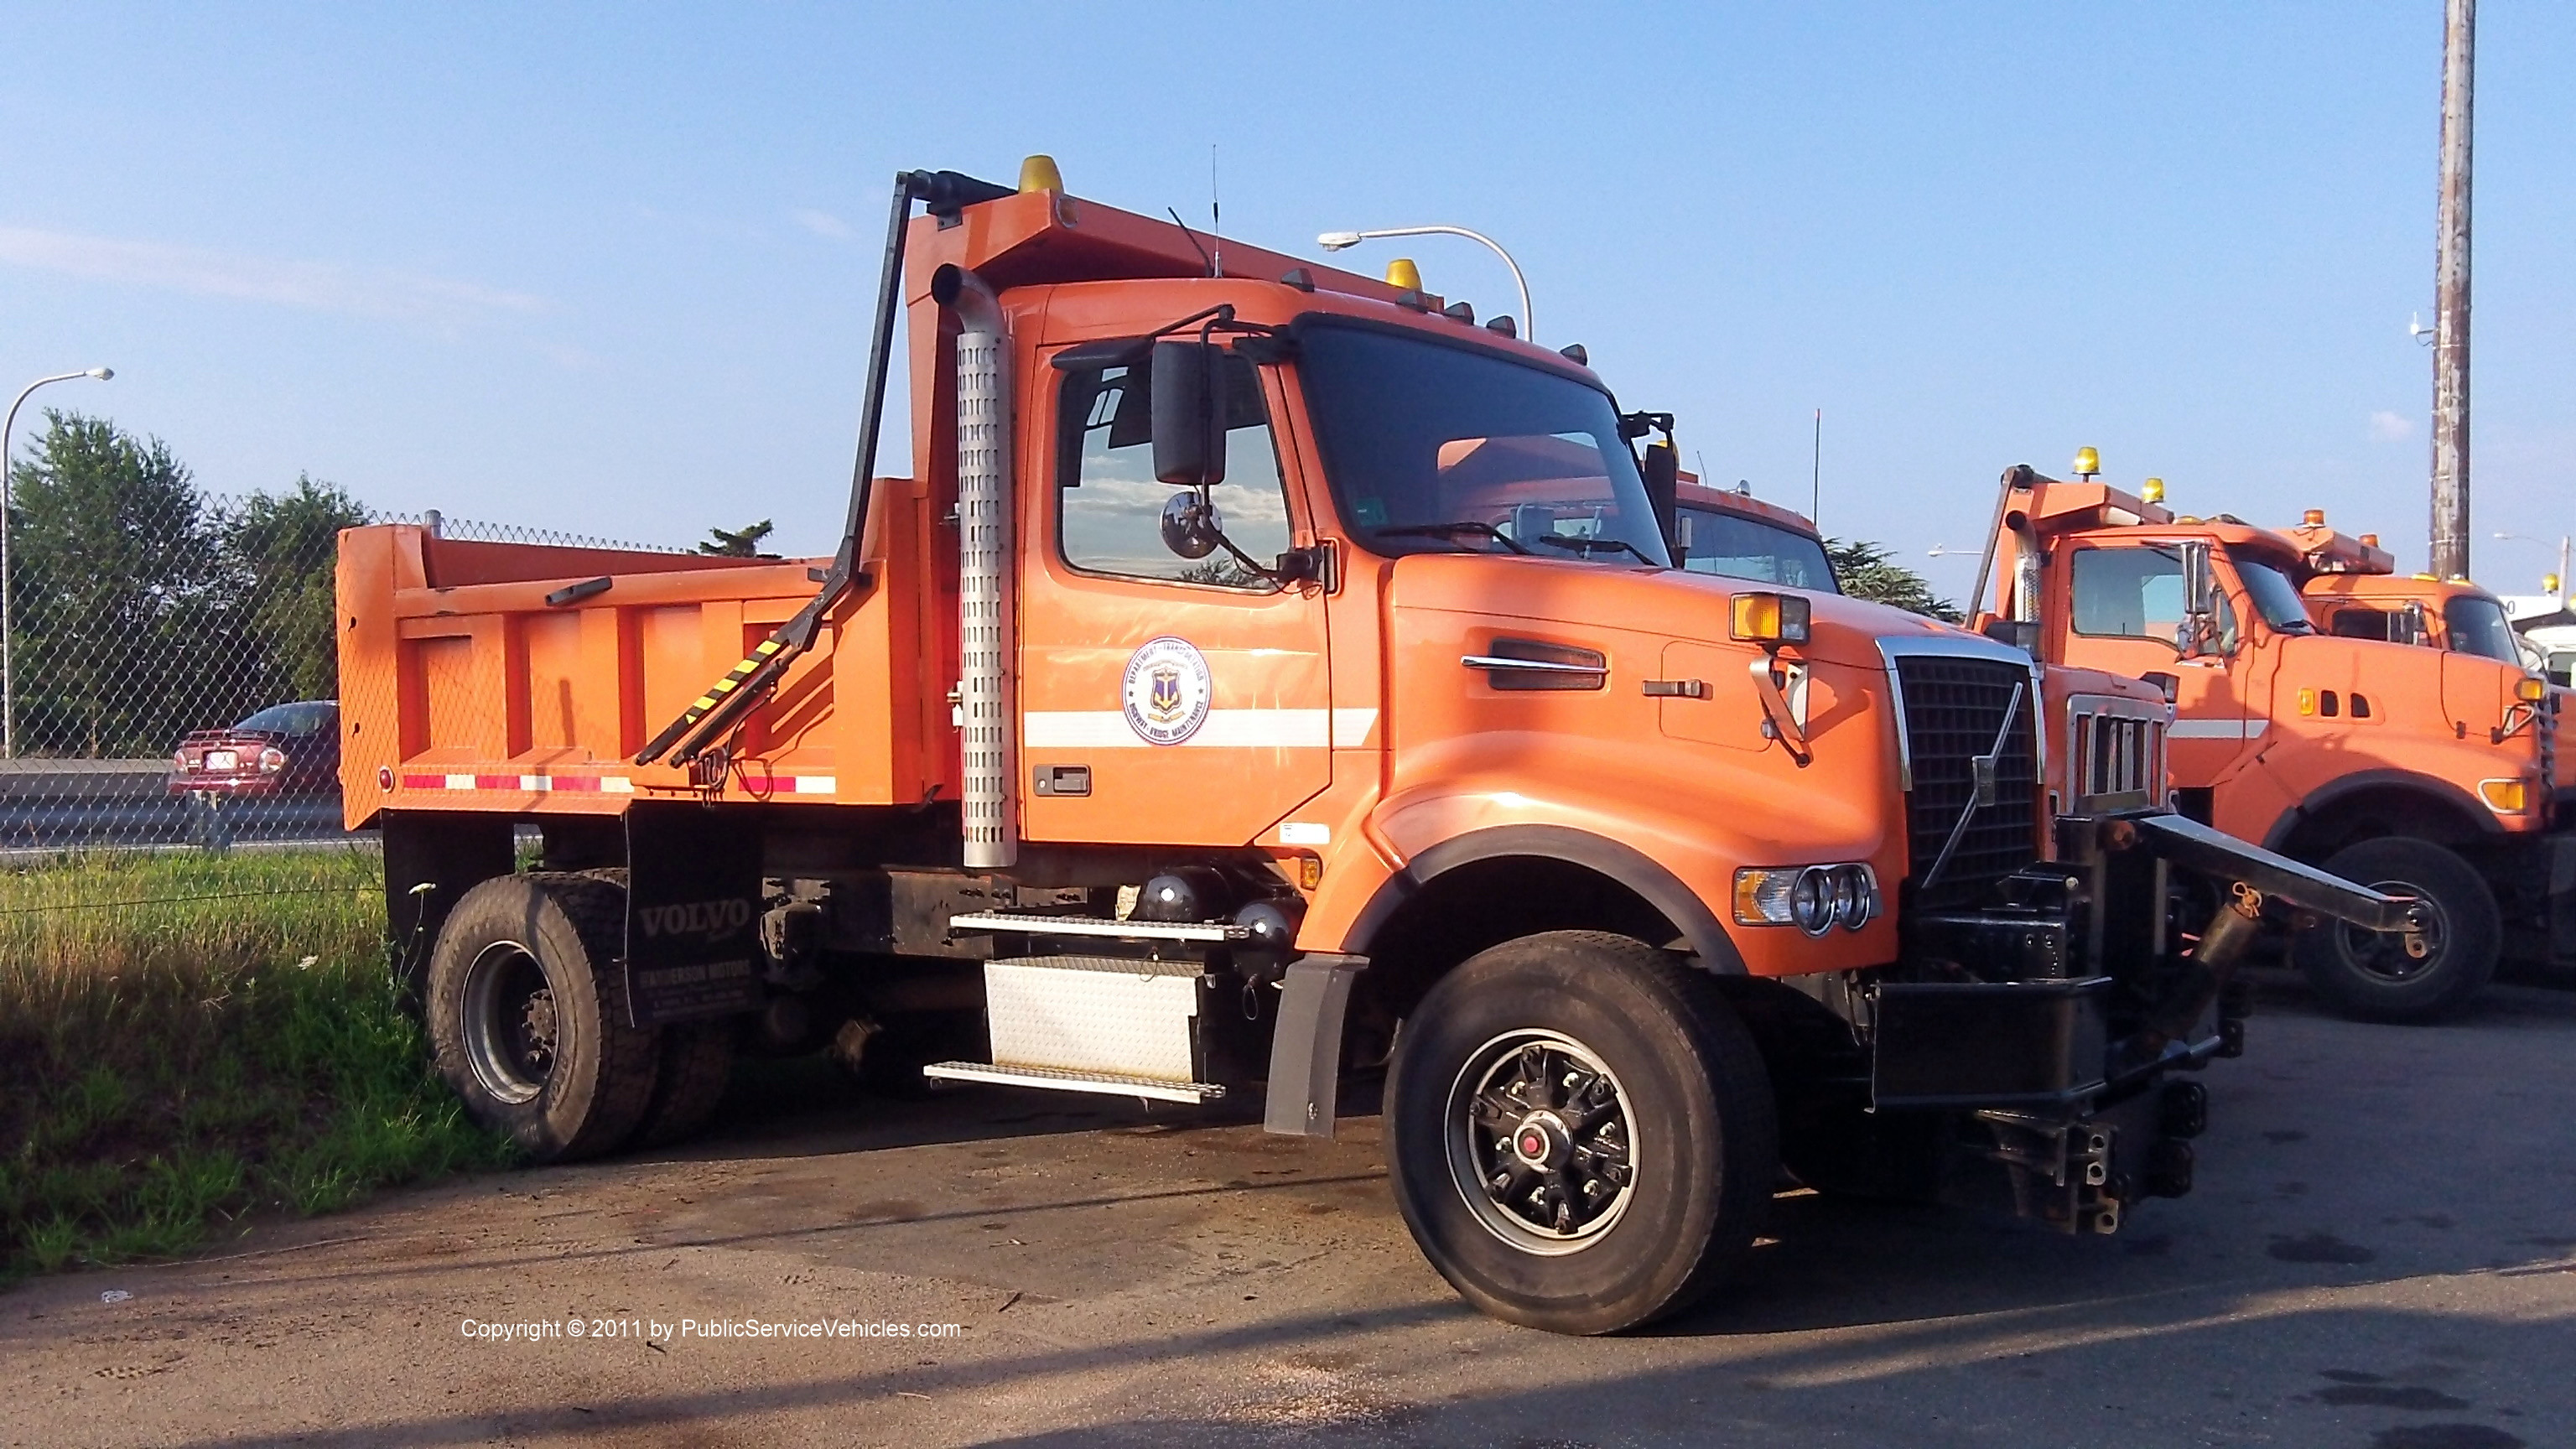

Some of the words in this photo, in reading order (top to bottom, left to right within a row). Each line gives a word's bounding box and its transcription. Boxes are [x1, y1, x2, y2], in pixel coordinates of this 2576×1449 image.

[1128, 647, 1157, 684] DEPARTMENT
[1171, 700, 1204, 737] MAINTENANCE
[639, 898, 750, 937] VOLVO
